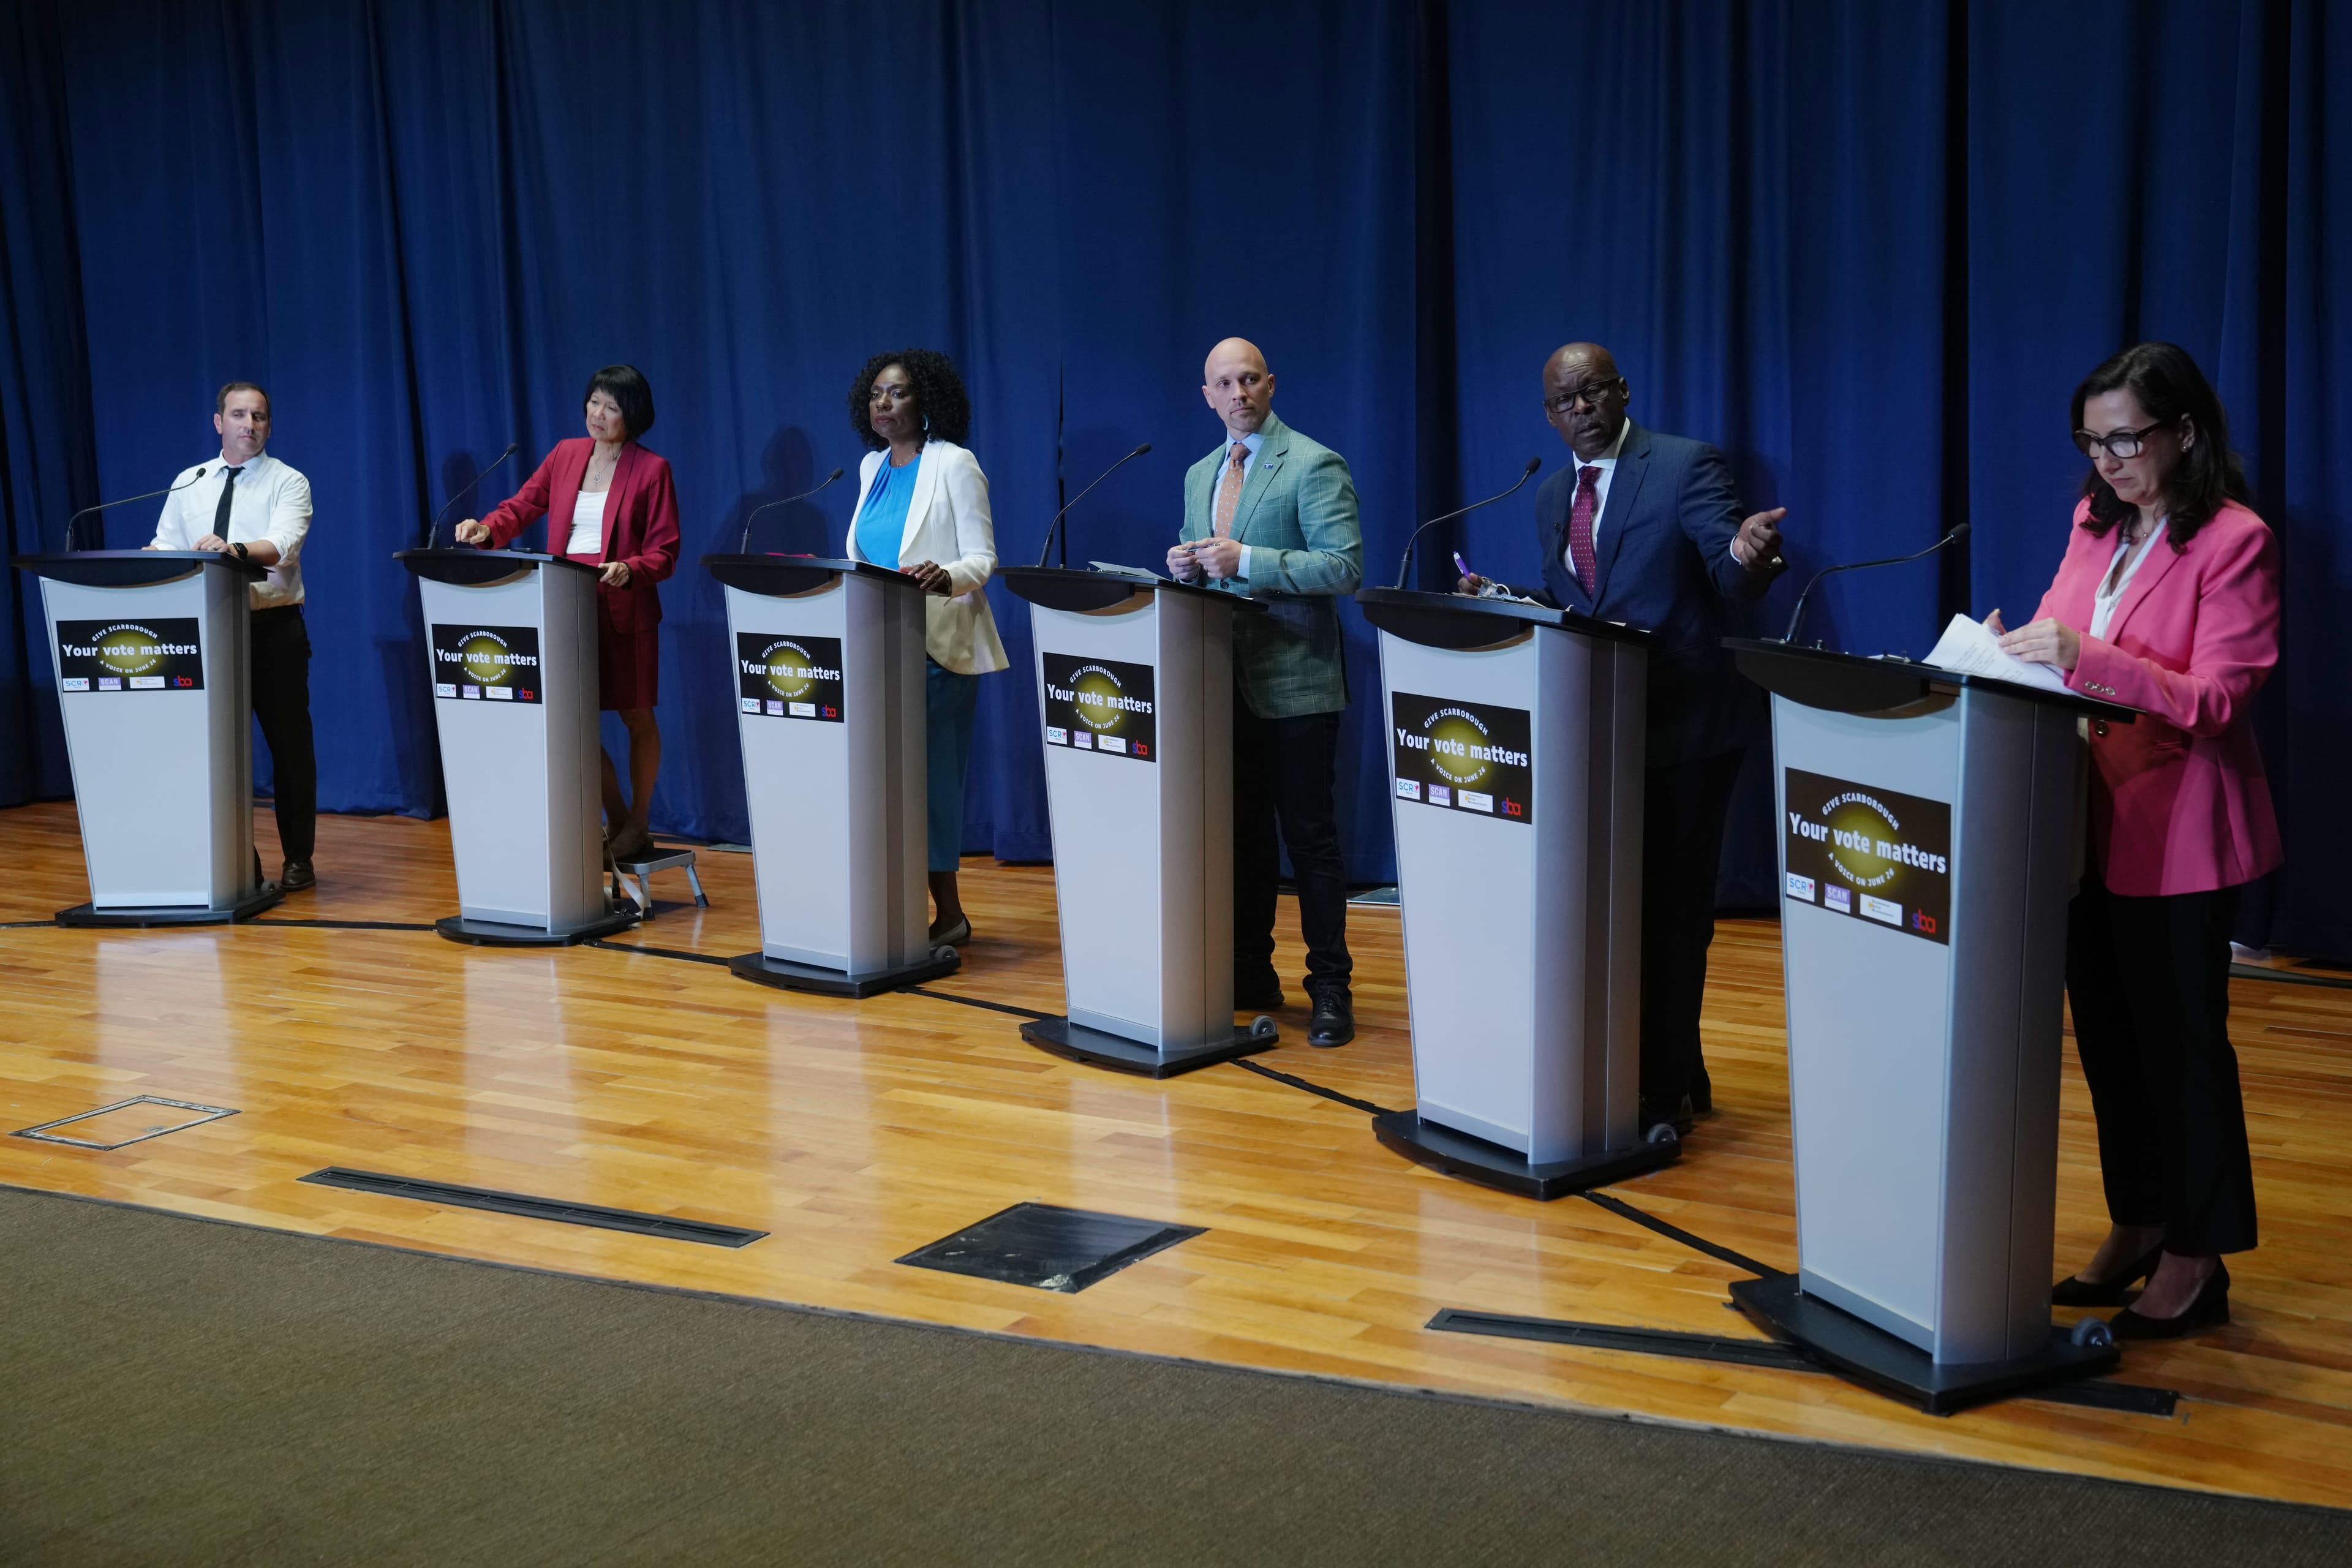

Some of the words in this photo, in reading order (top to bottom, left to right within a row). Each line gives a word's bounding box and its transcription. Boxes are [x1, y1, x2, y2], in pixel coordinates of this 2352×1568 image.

[92, 629, 107, 641] GIVE
[109, 624, 158, 639] SCARBOROUGH
[458, 635, 469, 647] GIVE
[470, 631, 508, 648] SCARBOROUGH
[62, 644, 98, 657] Your
[103, 645, 135, 656] vote
[141, 644, 197, 655] matters
[436, 649, 462, 662] Your
[466, 652, 490, 663] vote
[494, 653, 537, 666] matters
[762, 646, 773, 658] GIVE
[774, 641, 810, 660] SCARBOROUGH
[106, 664, 123, 673] VOICE
[135, 664, 149, 673] JUNE
[469, 671, 481, 682] VOICE
[490, 673, 501, 682] JUNE
[741, 660, 766, 674] Your
[770, 665, 793, 677] vote
[797, 666, 840, 680] matters
[1069, 669, 1082, 683] GIVE
[1083, 665, 1121, 688] SCARBOROUGH
[772, 684, 785, 696] VOICE
[794, 688, 804, 697] JUNE
[1047, 684, 1074, 701] Your
[1078, 692, 1102, 706] vote
[1107, 696, 1152, 714] matters
[1080, 712, 1093, 727] VOICE
[1102, 720, 1114, 729] JUNE
[1424, 712, 1439, 728] GIVE
[1440, 708, 1488, 736] SCARBOROUGH
[1076, 733, 1090, 741] SCAN
[1396, 728, 1430, 750] Your
[1434, 739, 1464, 756] vote
[1471, 744, 1528, 767] matters
[1436, 764, 1452, 780] VOICE
[1464, 773, 1478, 783] JUNE
[1479, 767, 1485, 775] 26
[1430, 786, 1447, 797] SCAN
[1822, 796, 1840, 816] GIVE
[1842, 793, 1899, 831] SCARBOROUGH
[1789, 812, 1828, 842] Your
[1833, 829, 1870, 853] vote
[1877, 840, 1946, 873] matters
[1835, 860, 1854, 881] VOICE
[1856, 877, 1866, 886] ON
[1868, 875, 1885, 887] JUNE
[1827, 887, 1847, 902] SCAN
